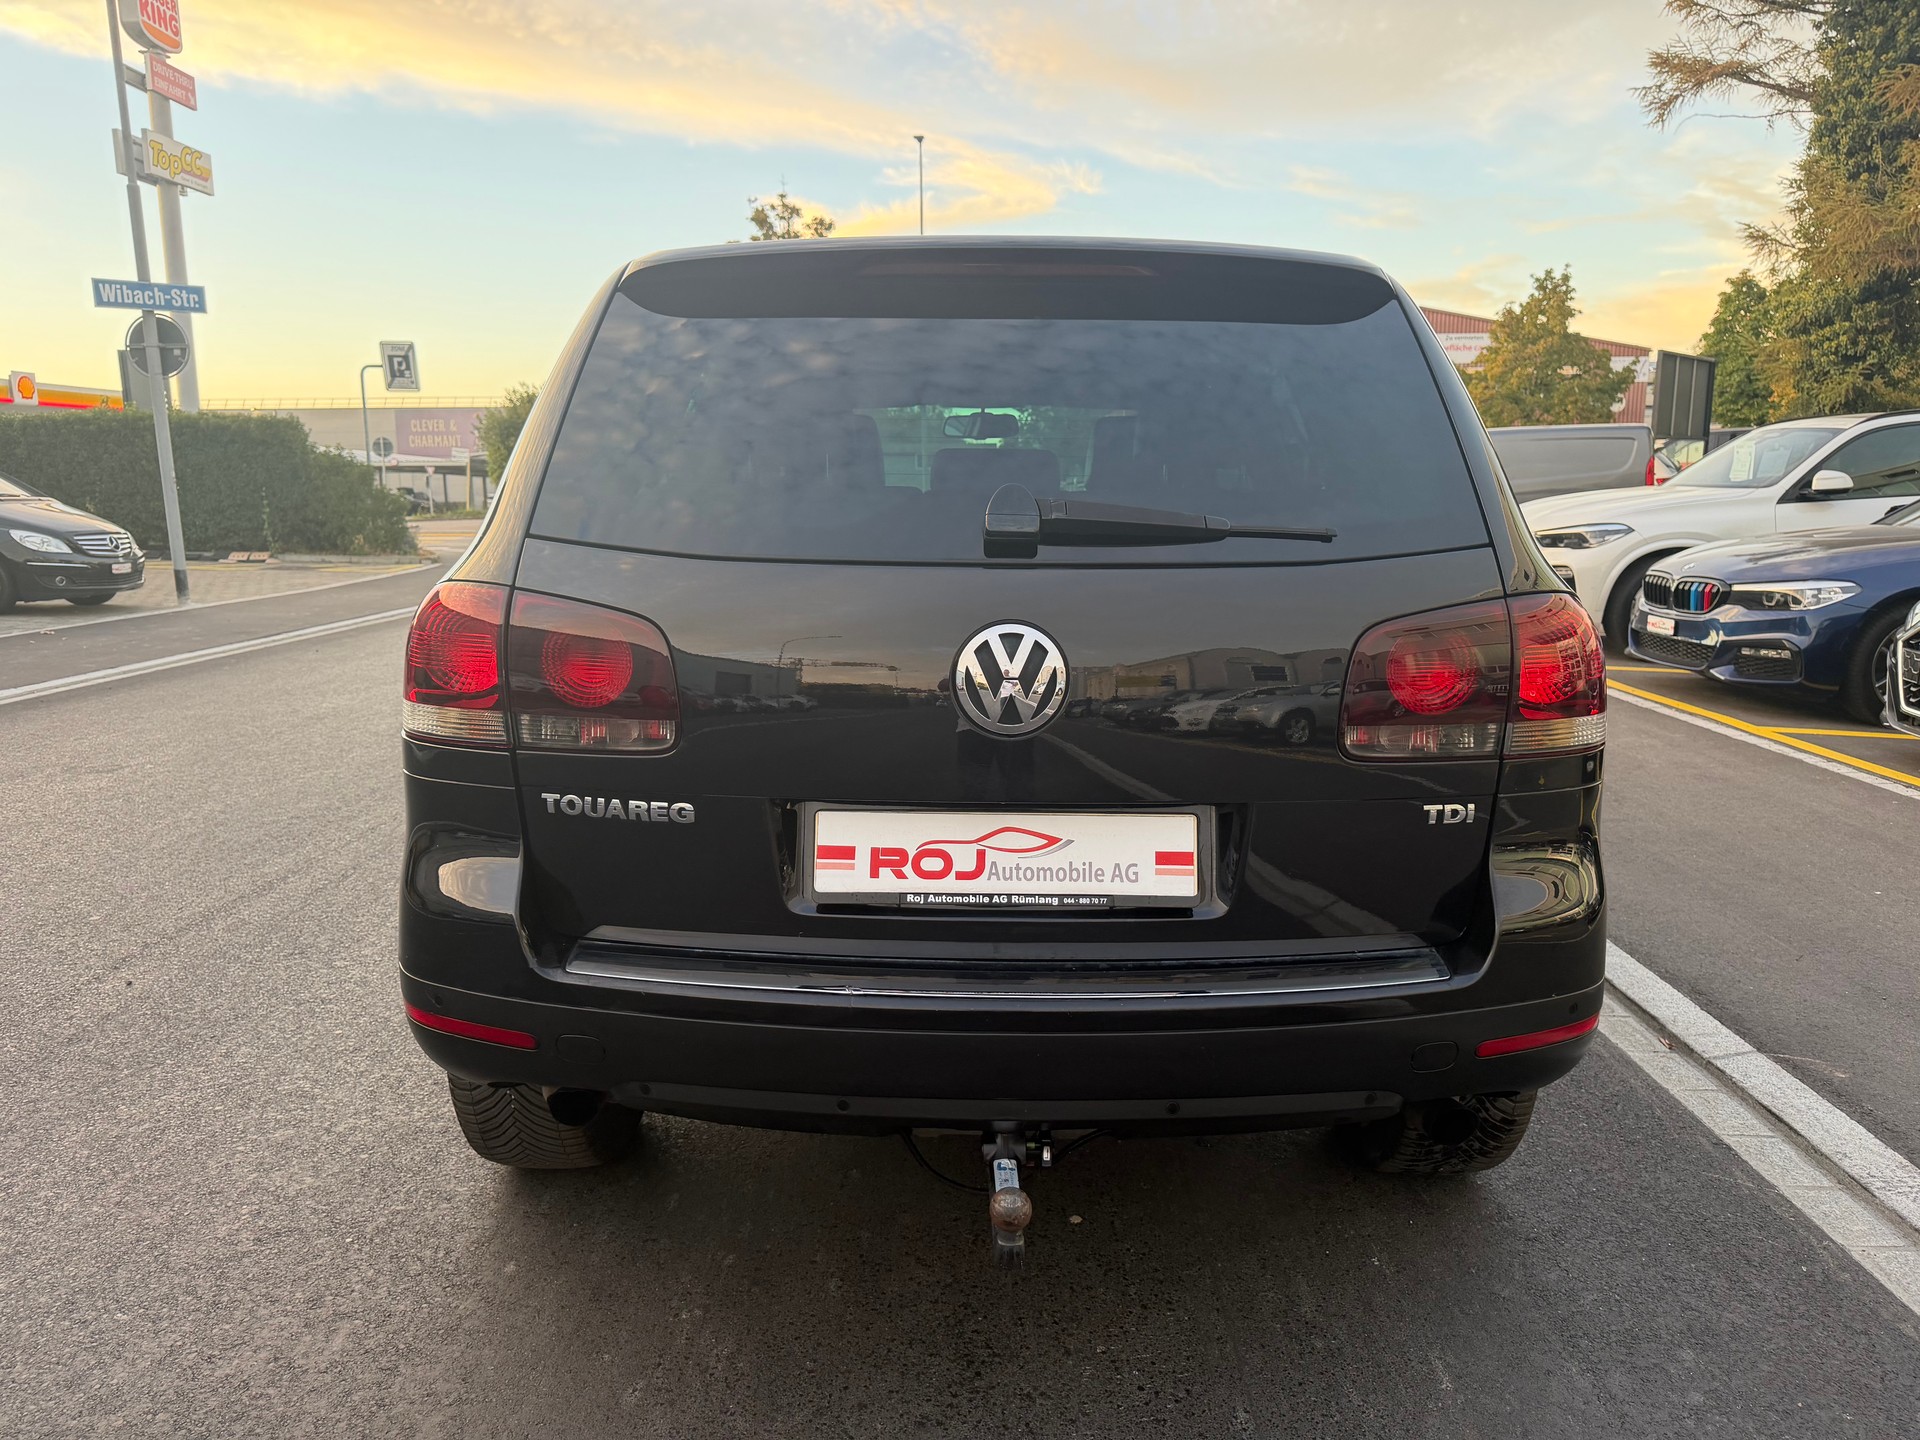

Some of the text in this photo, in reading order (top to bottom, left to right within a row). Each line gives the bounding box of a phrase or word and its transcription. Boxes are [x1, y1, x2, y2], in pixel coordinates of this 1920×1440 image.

[139, 0, 180, 37] KING
[153, 60, 193, 90] DRIVE THRU
[154, 76, 186, 101] EINFAHRT
[149, 139, 203, 179] TopCC
[98, 283, 200, 308] Wibach-Str.
[410, 419, 458, 432] CLEVER &
[408, 434, 462, 448] CHARMANT
[541, 792, 695, 824] TOUAREG
[1423, 803, 1475, 825] TDI
[869, 846, 1139, 883] ROJ Automobile AG
[906, 894, 924, 904] Roj
[928, 894, 990, 903] Automobile
[991, 895, 1008, 904] AG
[1011, 895, 1059, 905] Rümlang
